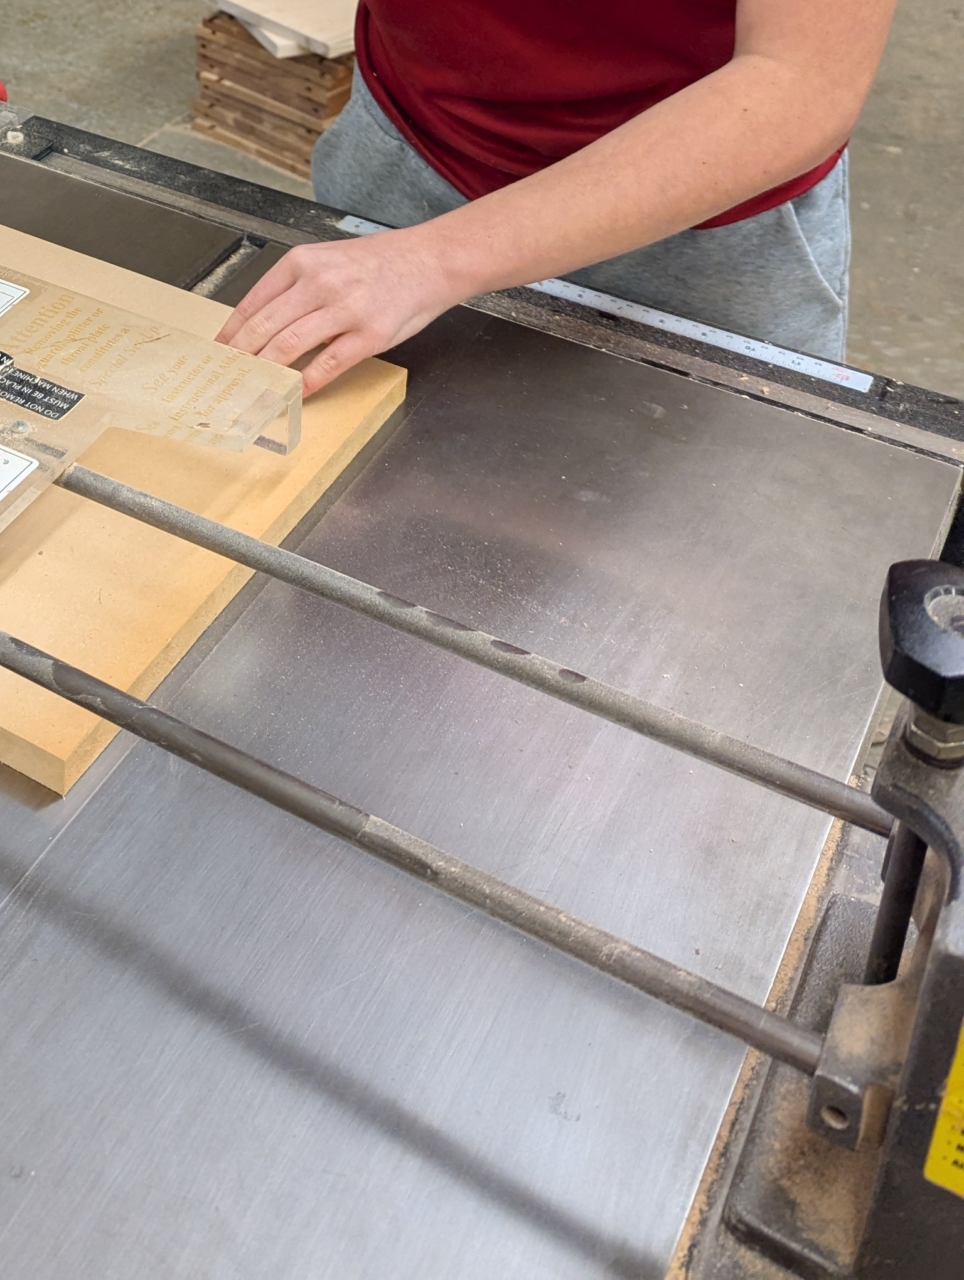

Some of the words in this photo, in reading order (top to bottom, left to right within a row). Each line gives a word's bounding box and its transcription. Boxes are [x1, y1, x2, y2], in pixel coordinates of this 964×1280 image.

[91, 307, 103, 317] or
[0, 294, 73, 352] Attention
[23, 318, 70, 354] Removing
[65, 307, 82, 318] the
[60, 341, 90, 365] throat
[84, 323, 110, 343] plate
[79, 333, 122, 372] constitutes
[88, 353, 128, 385] Special
[202, 354, 213, 364] or
[11, 364, 52, 389] MACHINE
[141, 372, 169, 393] See
[167, 355, 187, 375] your
[31, 390, 44, 399] BE
[51, 382, 78, 400] WHEN
[24, 401, 44, 412] NOT
[42, 396, 69, 409] MUST
[43, 409, 59, 418] DO
